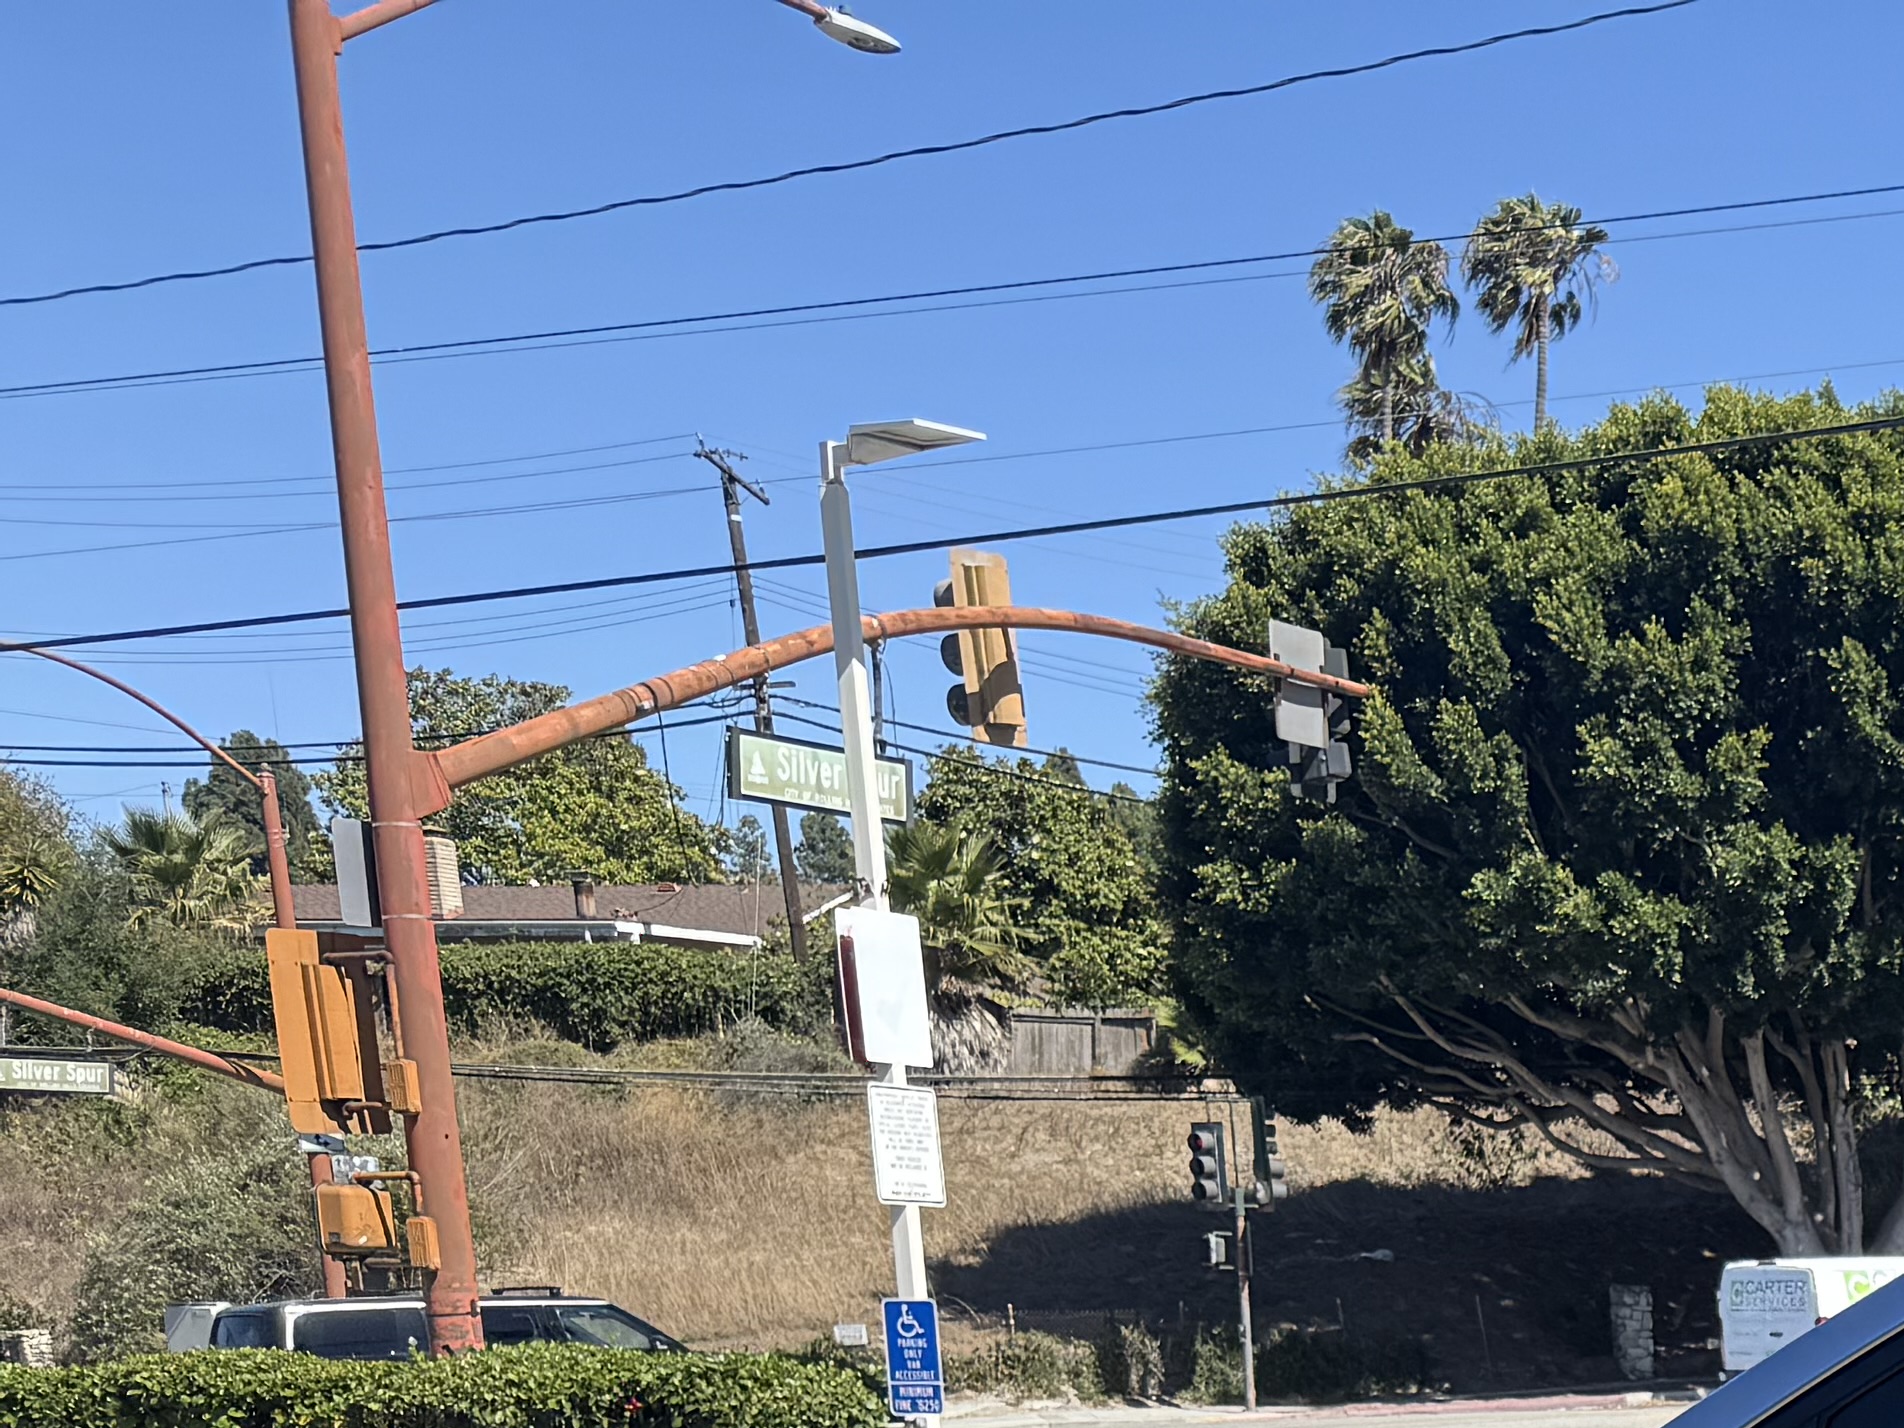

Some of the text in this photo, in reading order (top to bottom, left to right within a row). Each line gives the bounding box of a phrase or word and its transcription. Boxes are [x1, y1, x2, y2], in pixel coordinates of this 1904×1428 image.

[777, 746, 900, 800] Silver ur
[12, 1061, 104, 1083] Silver Spur
[1744, 1280, 1807, 1295] CARTER
[1745, 1297, 1806, 1307] SERVICES
[897, 1338, 927, 1348] PARKING
[903, 1349, 922, 1359] ONLY
[907, 1360, 921, 1369] VAN
[895, 1370, 934, 1380] ACCESSIBLE
[899, 1387, 933, 1397] MINIMUM
[895, 1399, 911, 1411] FINE
